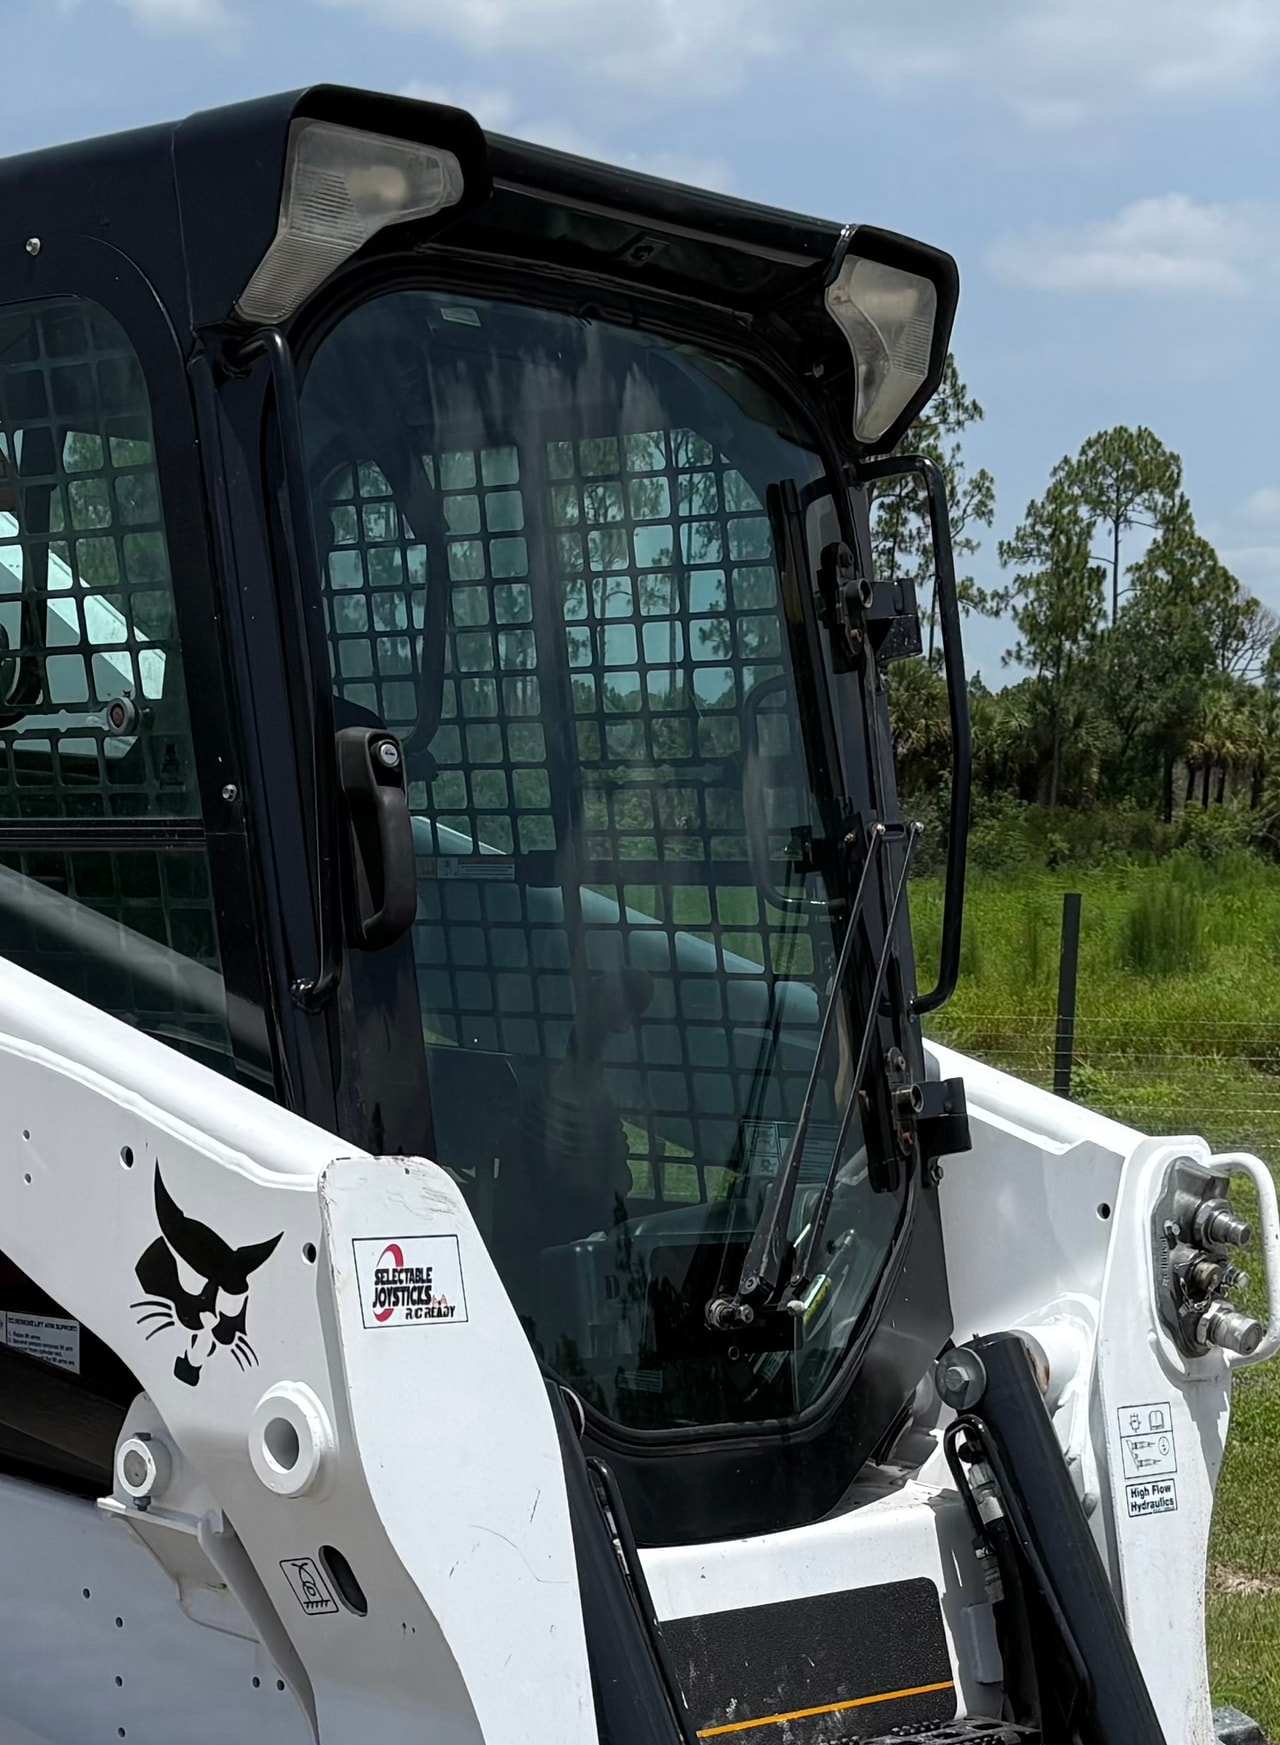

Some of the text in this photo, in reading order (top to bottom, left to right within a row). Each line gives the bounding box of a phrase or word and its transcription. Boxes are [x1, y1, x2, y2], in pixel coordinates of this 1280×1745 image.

[374, 1267, 433, 1286] SELECTABLE
[372, 1284, 432, 1308] JOYSTICKS
[424, 1305, 456, 1318] READY
[1130, 1484, 1171, 1500] High Flow
[1130, 1496, 1174, 1513] Hydraulics
